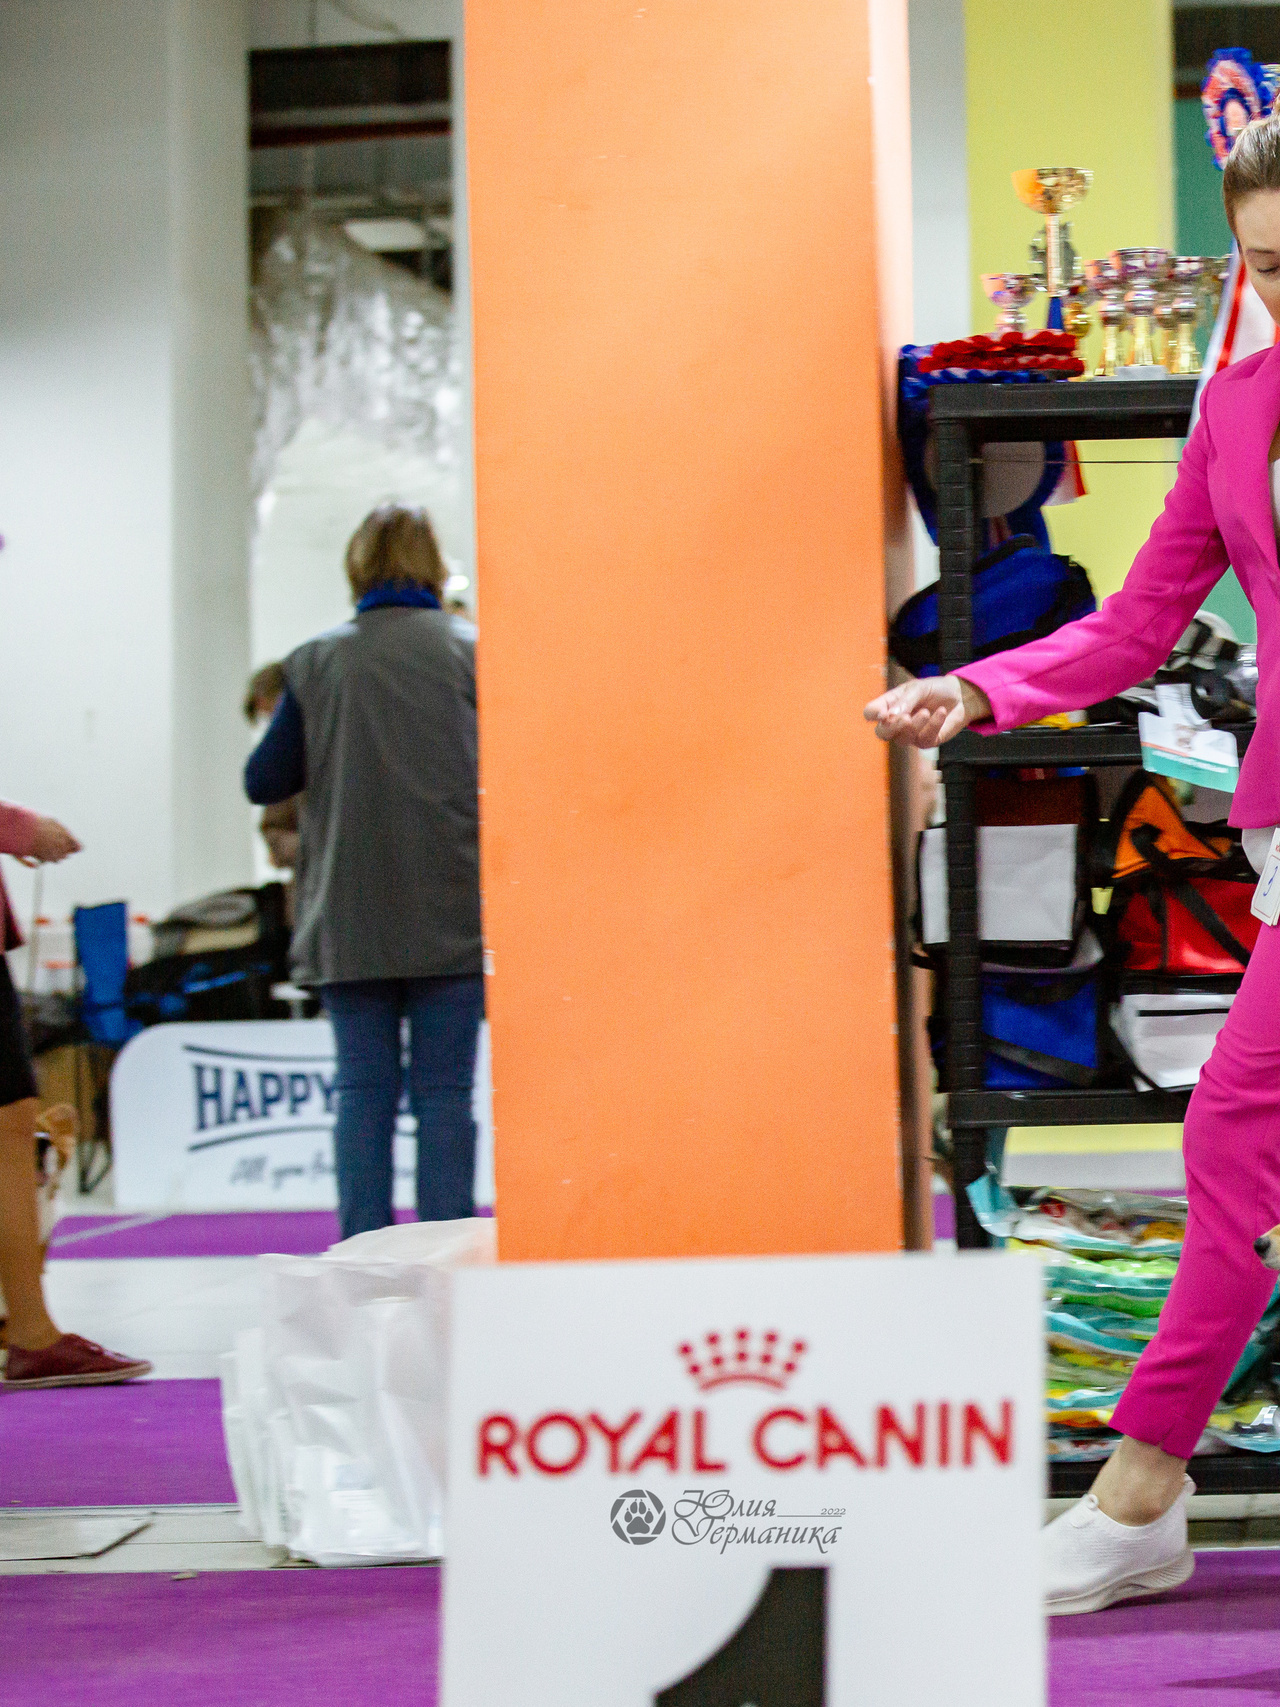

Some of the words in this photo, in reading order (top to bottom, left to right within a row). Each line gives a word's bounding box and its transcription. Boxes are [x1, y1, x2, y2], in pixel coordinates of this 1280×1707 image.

[193, 1063, 338, 1132] HAPPY
[477, 1407, 729, 1479] ROYAL
[750, 1398, 1015, 1471] CANIN
